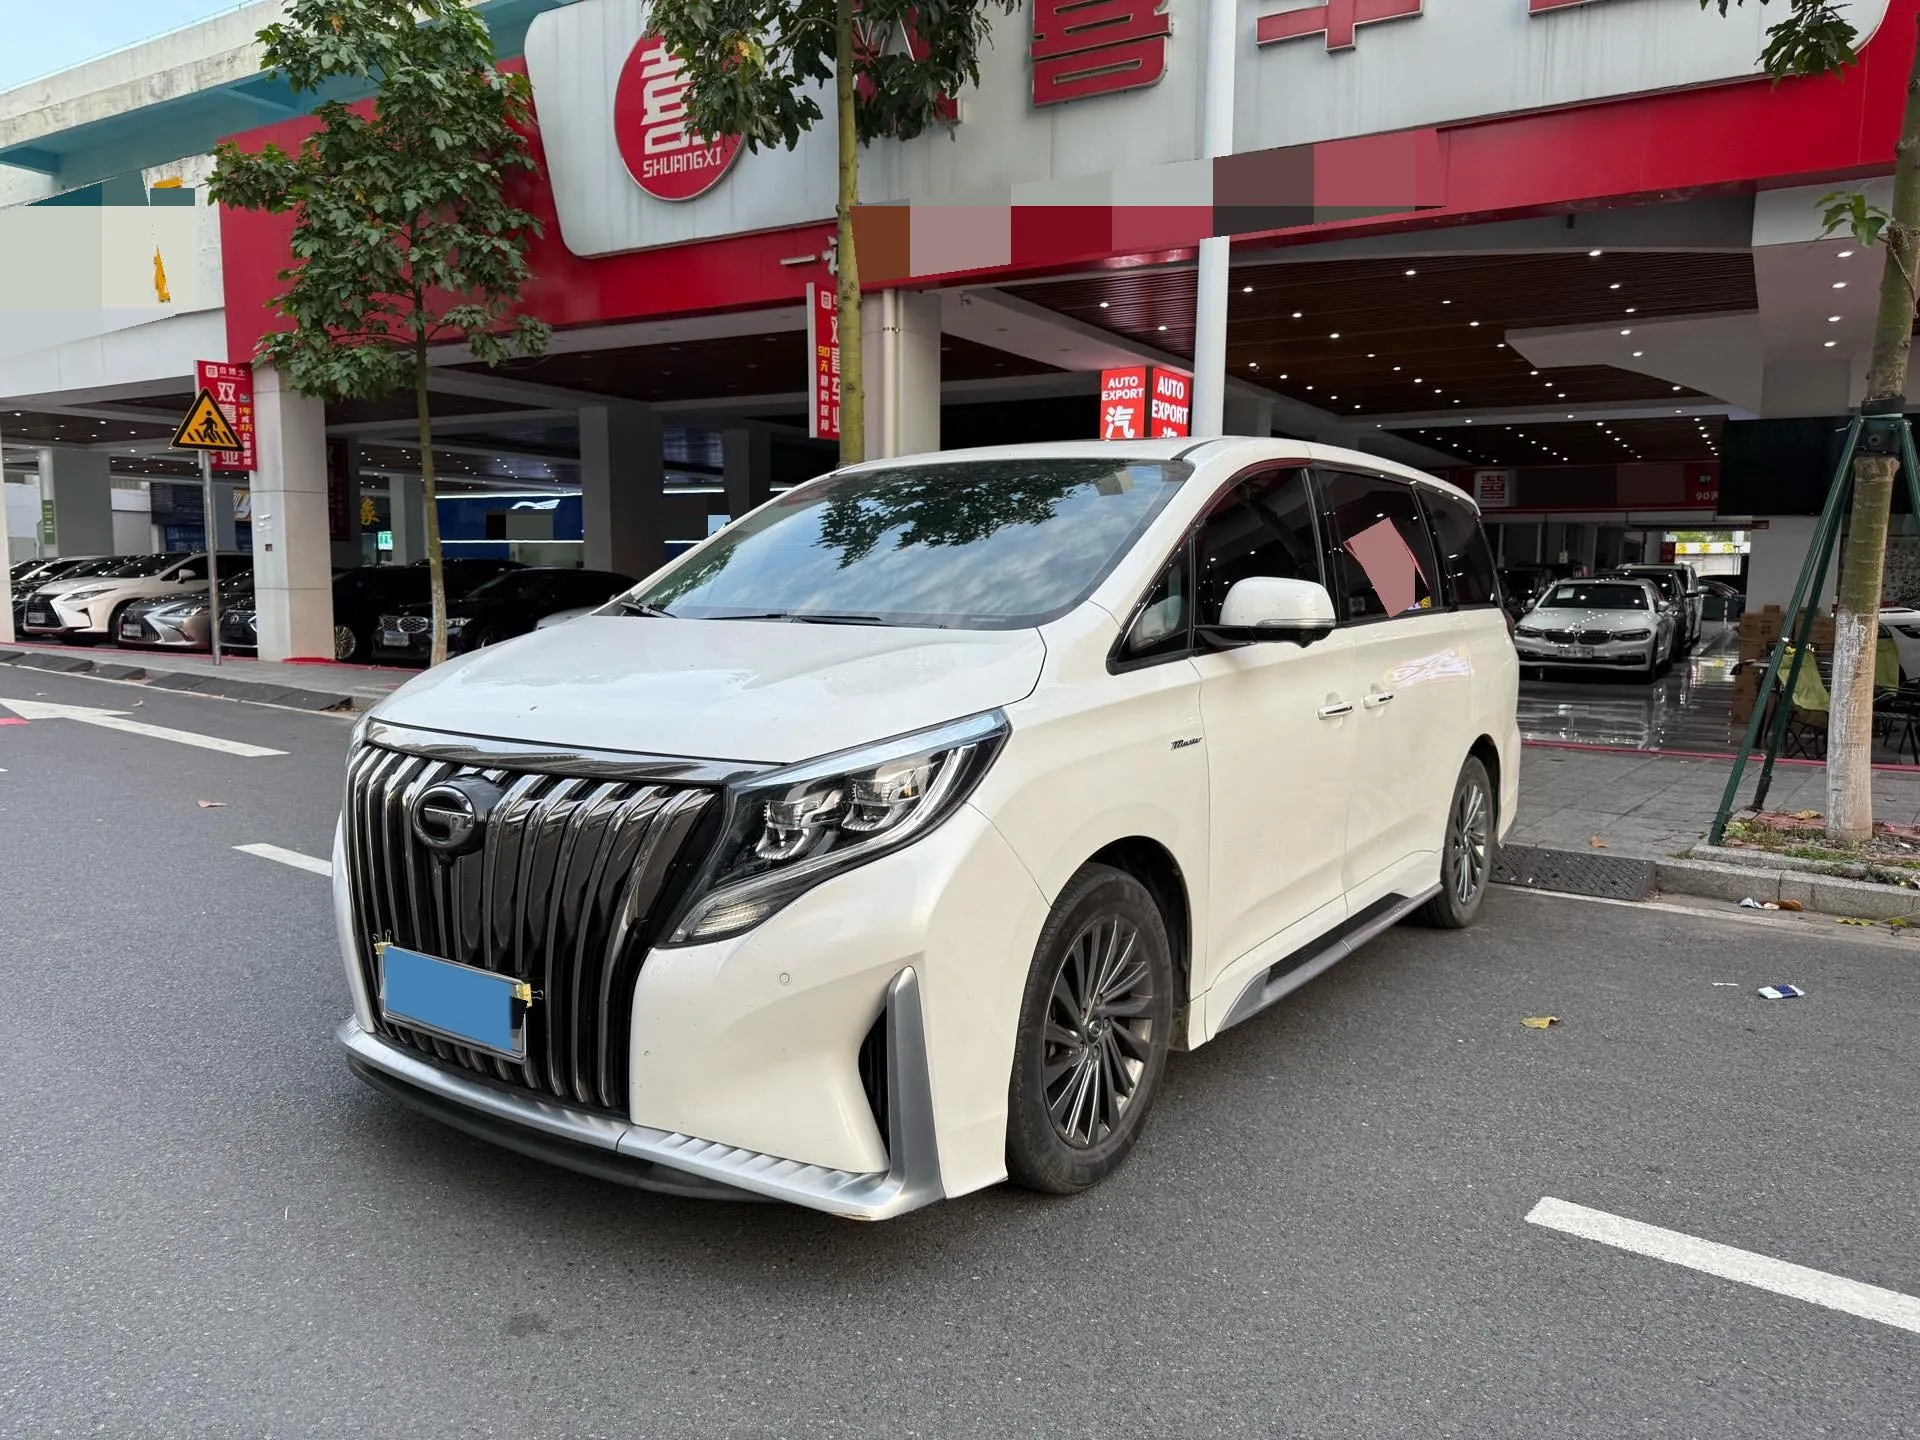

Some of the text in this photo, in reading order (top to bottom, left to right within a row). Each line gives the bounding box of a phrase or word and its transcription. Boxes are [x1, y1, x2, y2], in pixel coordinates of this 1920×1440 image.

[642, 146, 722, 179] SHUANGXI
[1102, 388, 1144, 401] EXPORT
[1107, 376, 1139, 389] AUTO
[1157, 375, 1184, 399] AUTO
[1105, 405, 1135, 441] 汽
[1152, 399, 1189, 425] EXPORT
